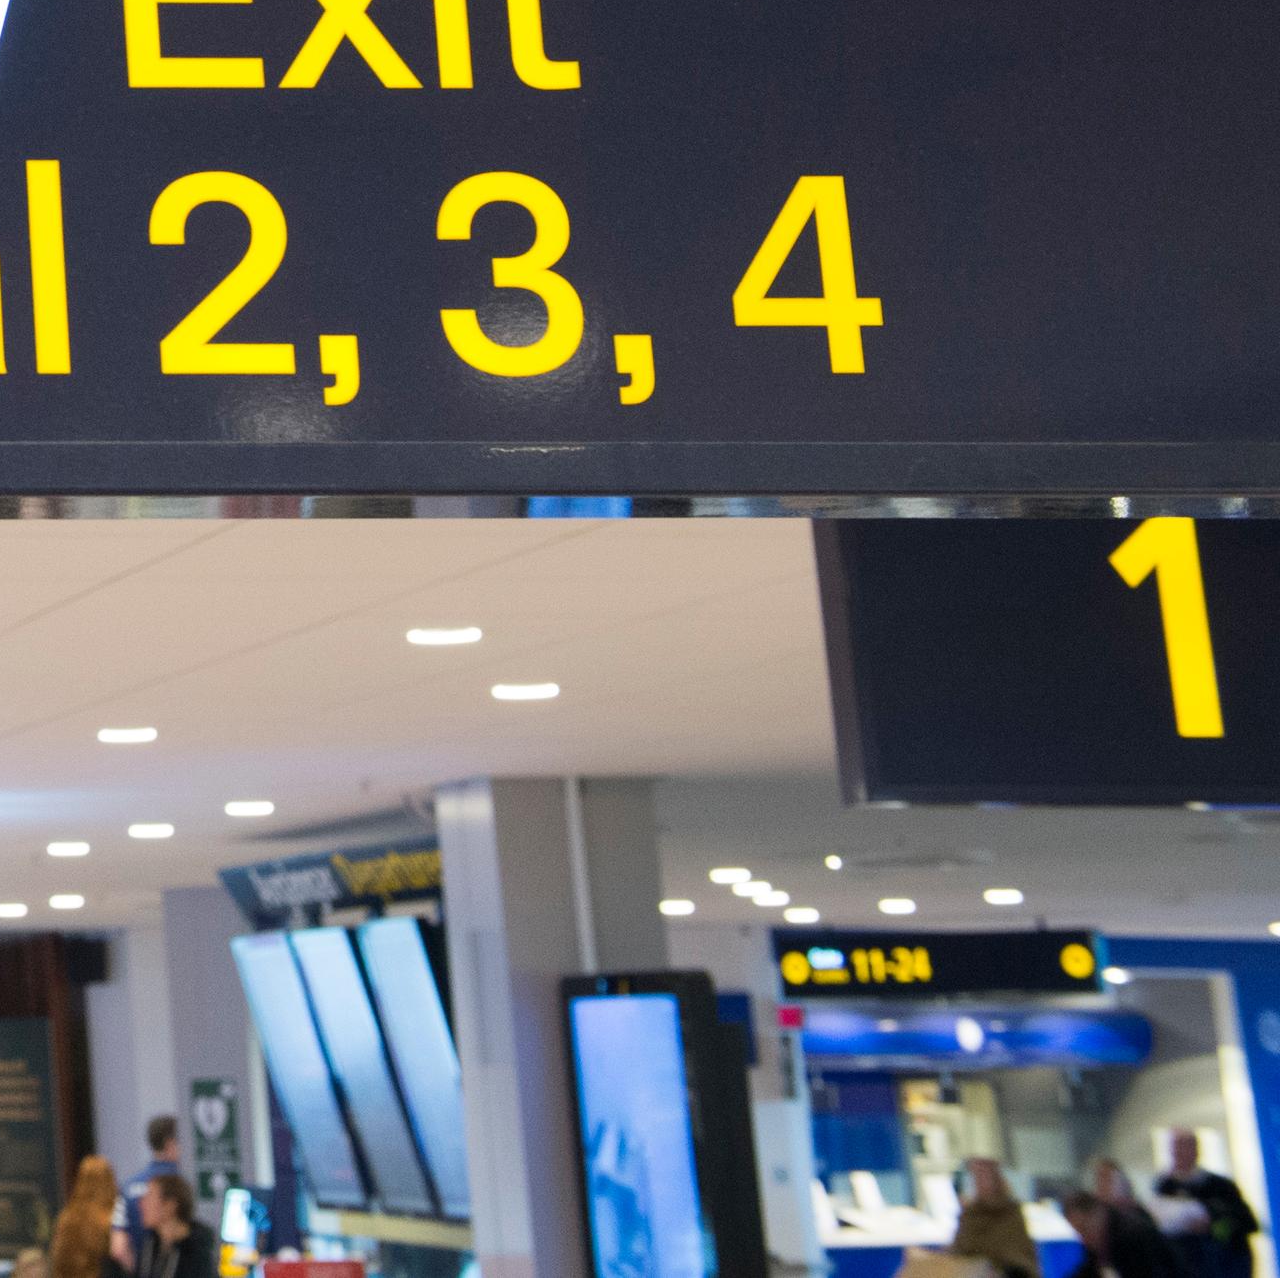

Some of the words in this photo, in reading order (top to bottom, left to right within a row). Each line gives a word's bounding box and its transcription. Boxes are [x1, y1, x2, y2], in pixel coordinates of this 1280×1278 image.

[148, 170, 360, 406] 2,
[436, 171, 656, 405] 3,
[732, 175, 884, 374] 4
[1109, 516, 1224, 738] 1
